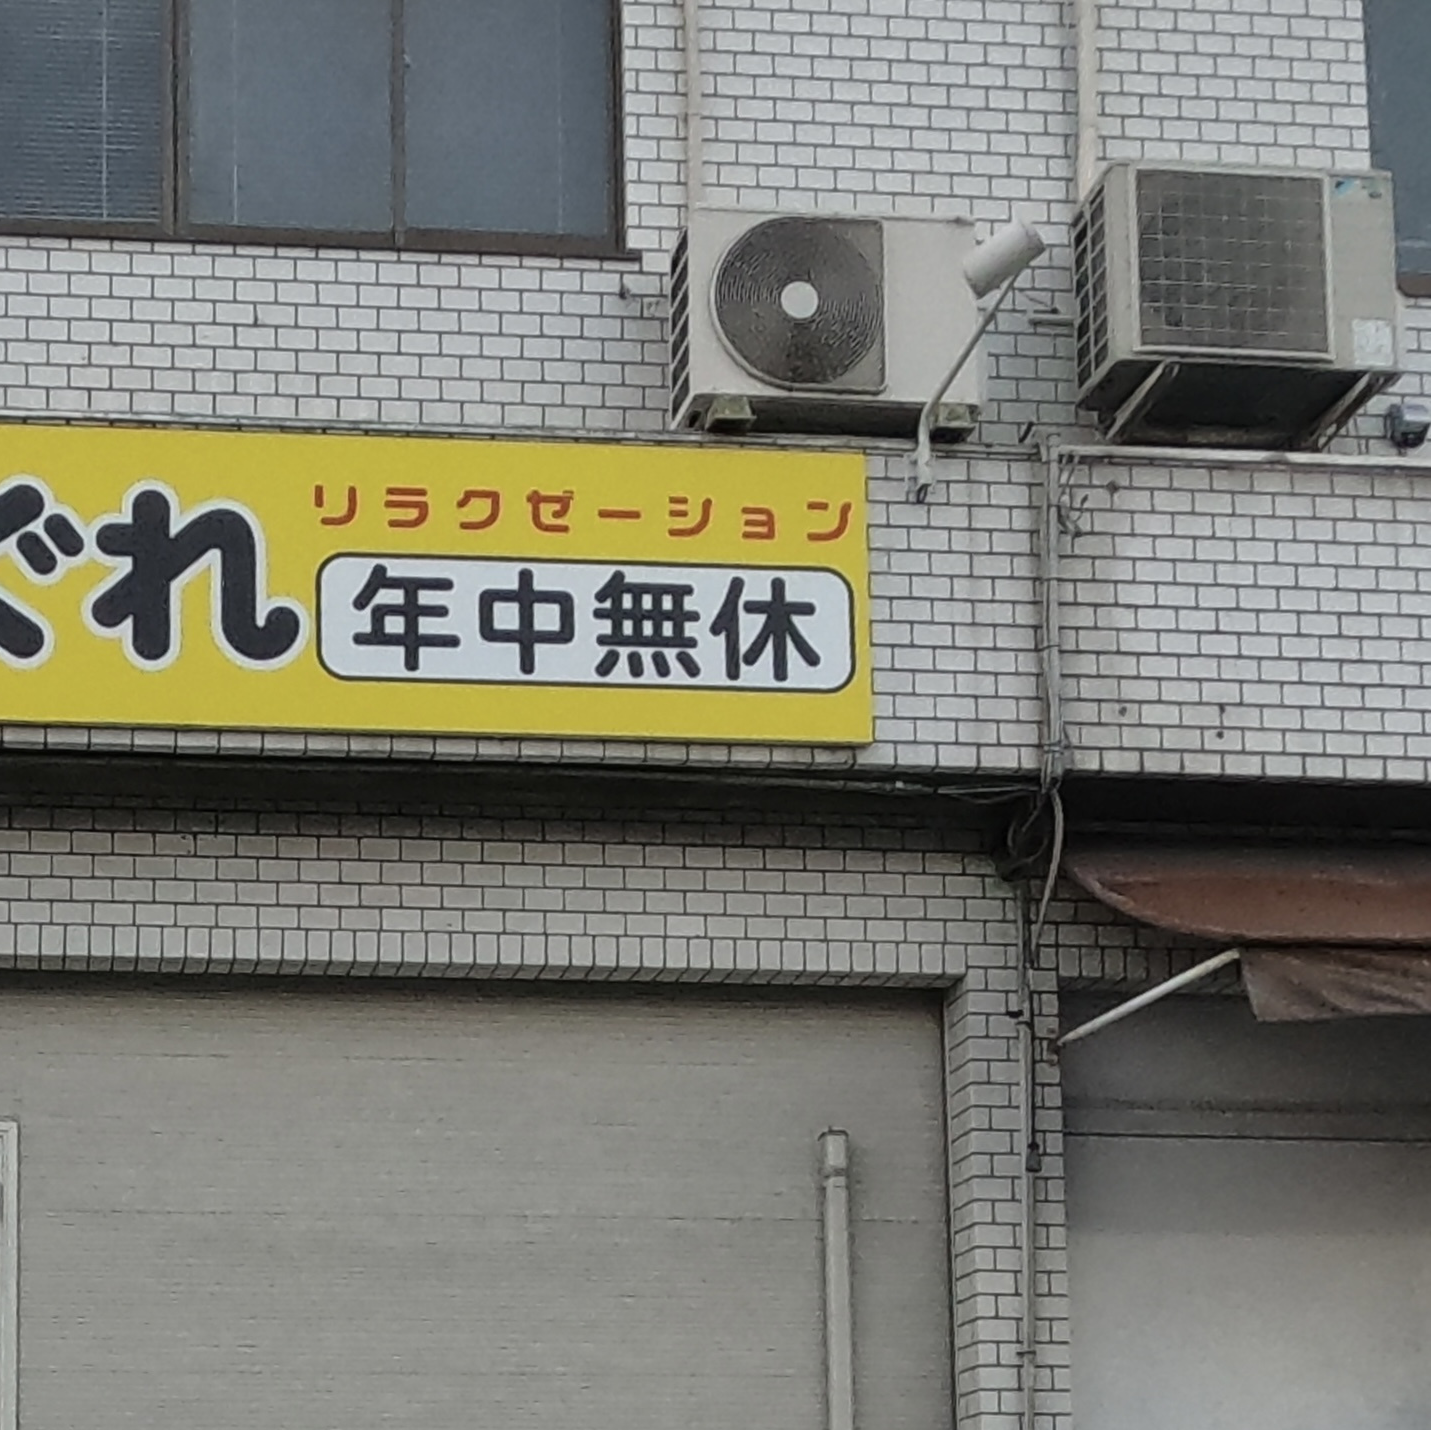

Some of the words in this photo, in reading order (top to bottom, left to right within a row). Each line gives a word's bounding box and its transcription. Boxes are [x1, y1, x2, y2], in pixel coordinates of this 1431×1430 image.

[314, 485, 851, 542] リラクゼーション
[352, 564, 821, 682] 年中無休
